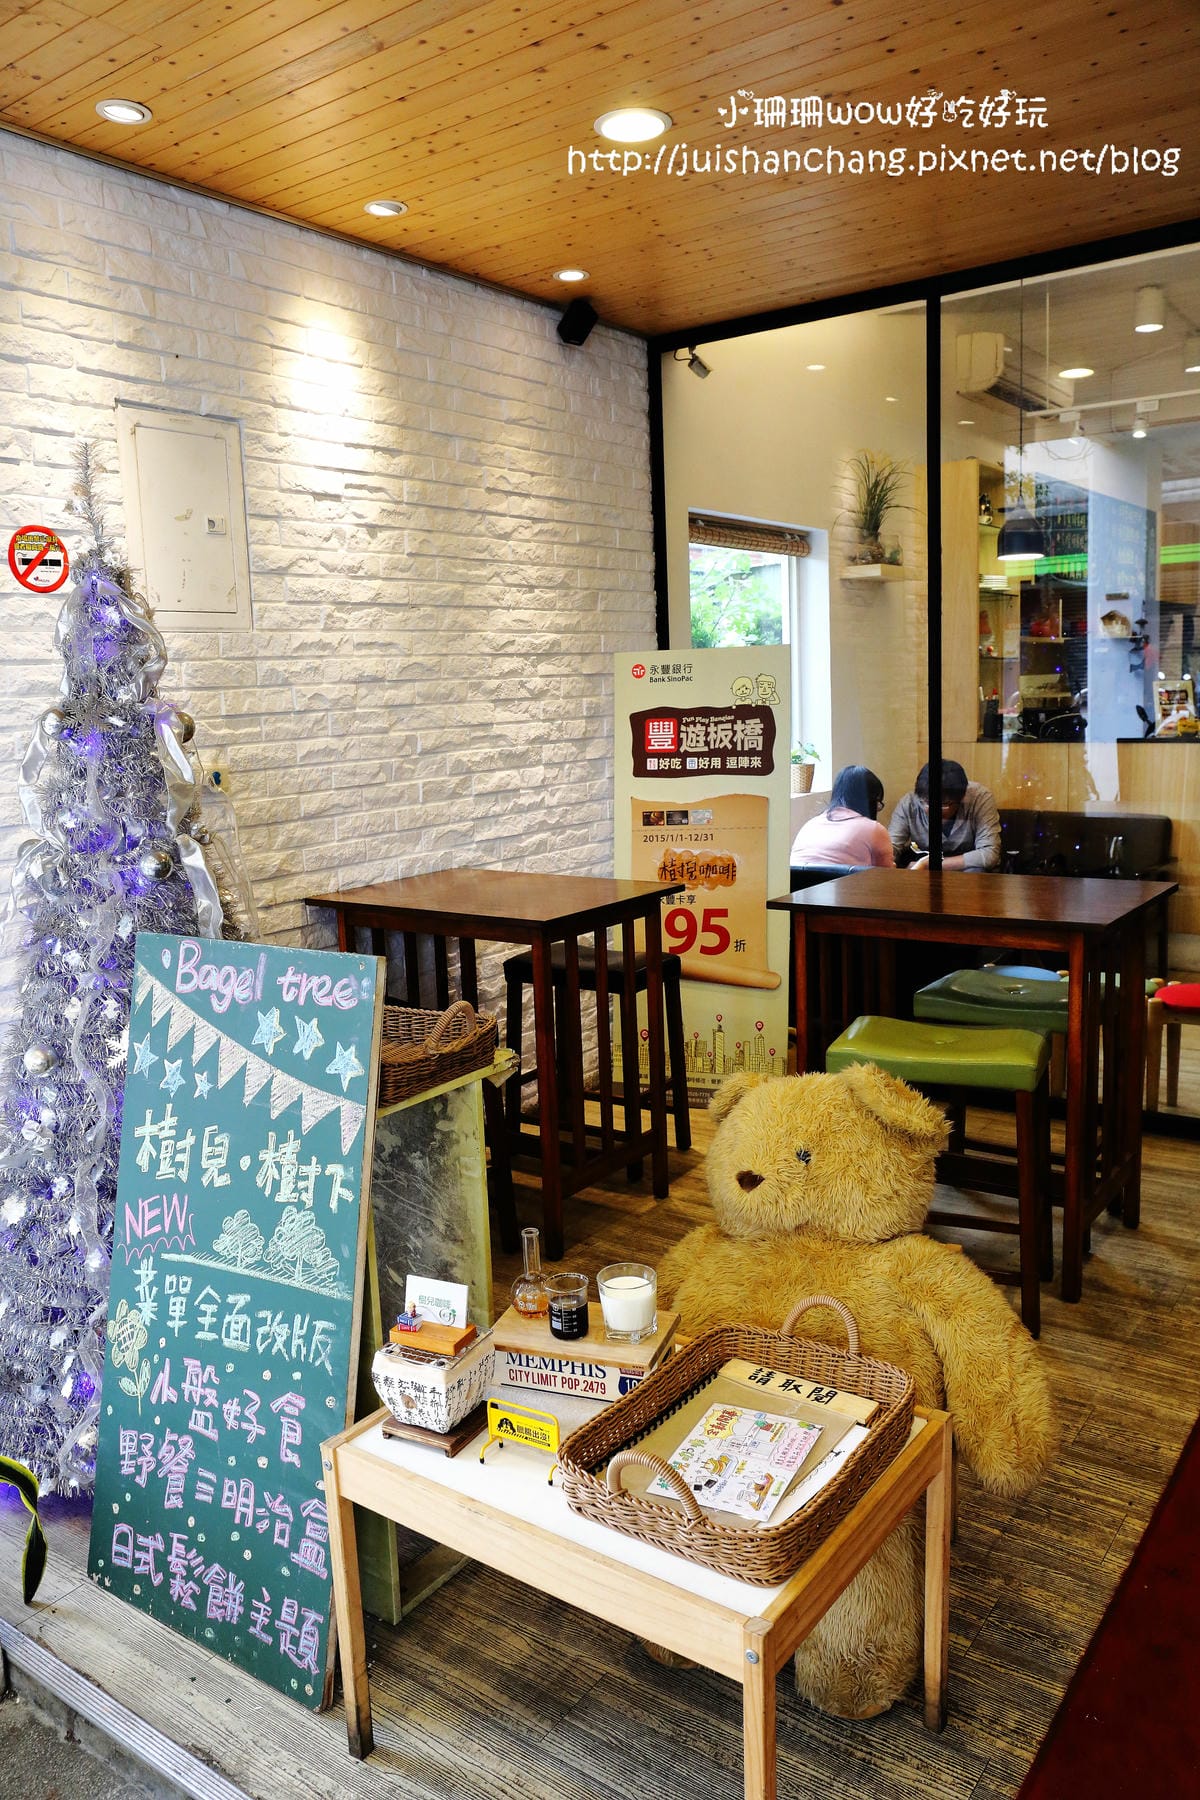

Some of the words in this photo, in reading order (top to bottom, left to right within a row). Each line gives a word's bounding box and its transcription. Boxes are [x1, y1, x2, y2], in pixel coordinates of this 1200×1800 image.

[650, 664, 693, 676] 永豐銀行
[726, 756, 762, 769] 逗陣來
[643, 833, 714, 843] 2015/1/1-12/31
[175, 939, 268, 1014] Bagel
[276, 966, 359, 1011] tree
[124, 1192, 190, 1246] NEW
[132, 1255, 337, 1377] 菜單全面改版
[505, 1351, 607, 1380] MEMPHIS
[508, 1368, 531, 1384] CITY
[531, 1371, 558, 1388] LIMIT
[747, 1367, 839, 1405] 請取閱
